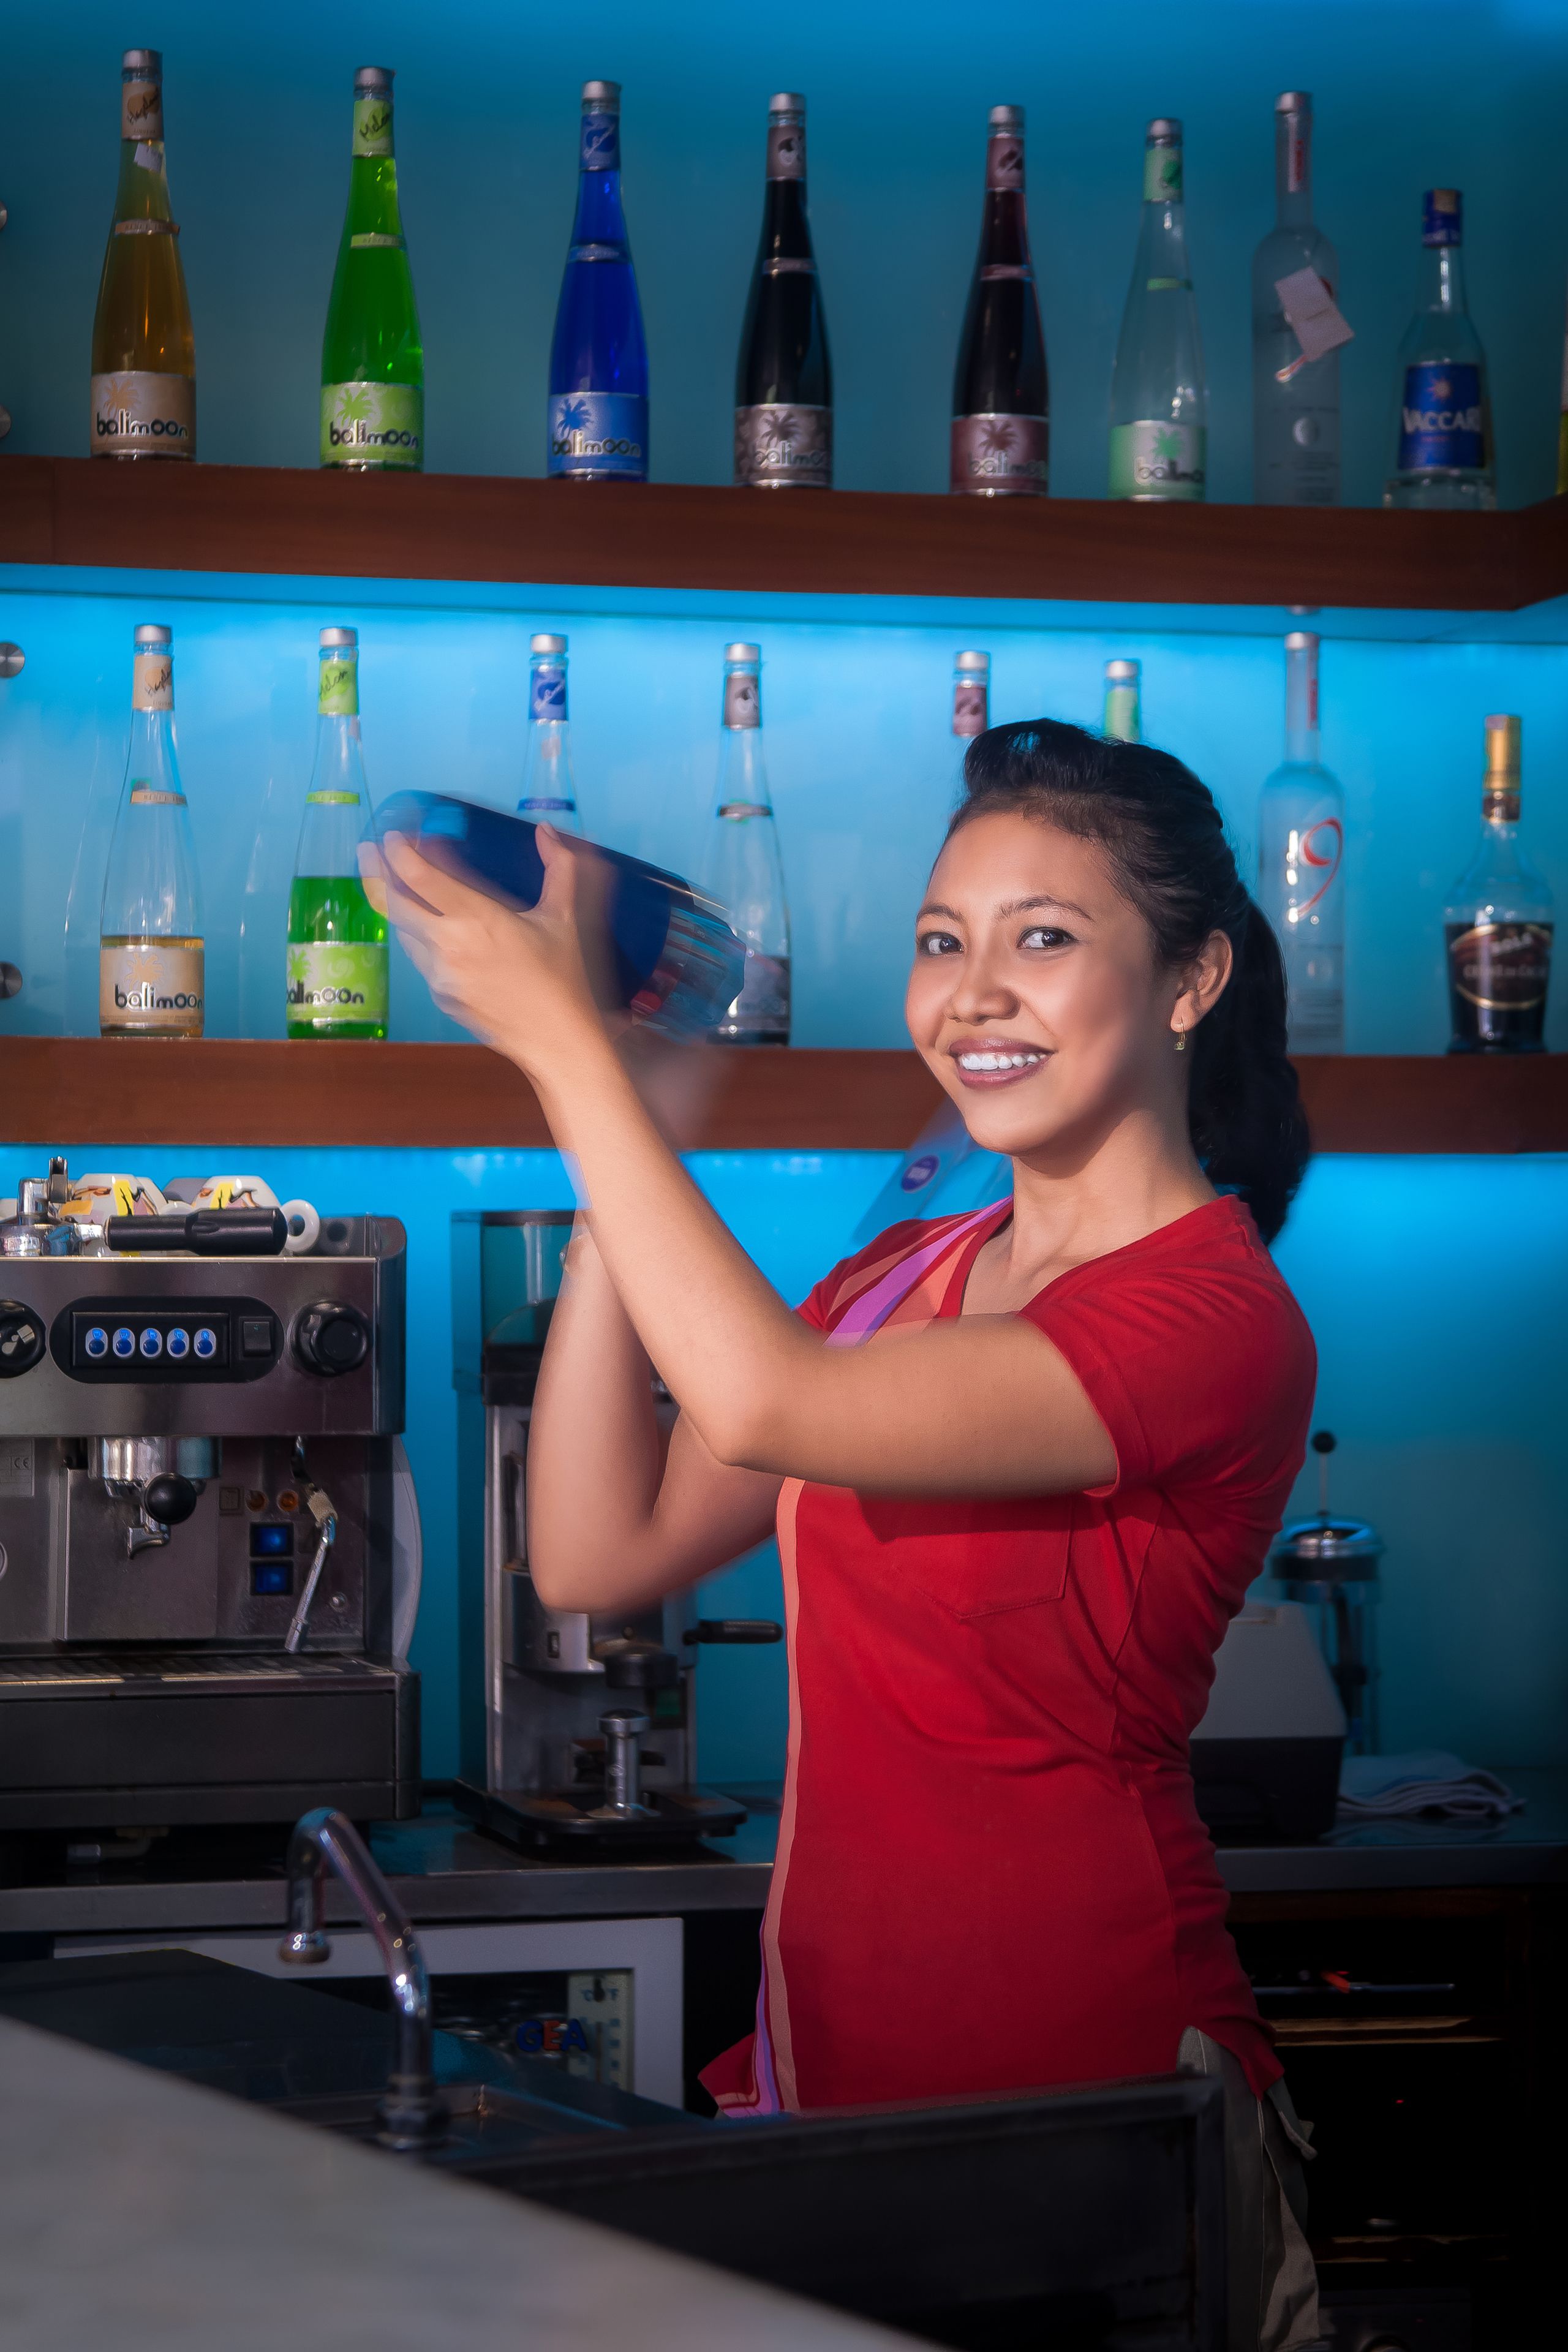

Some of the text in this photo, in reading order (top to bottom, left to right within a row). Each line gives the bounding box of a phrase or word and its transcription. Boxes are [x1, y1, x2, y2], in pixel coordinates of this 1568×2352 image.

[96, 409, 189, 439] balimoon
[329, 418, 420, 448] balimoon
[115, 981, 203, 1010] balimoon
[516, 2018, 587, 2052] GEA
